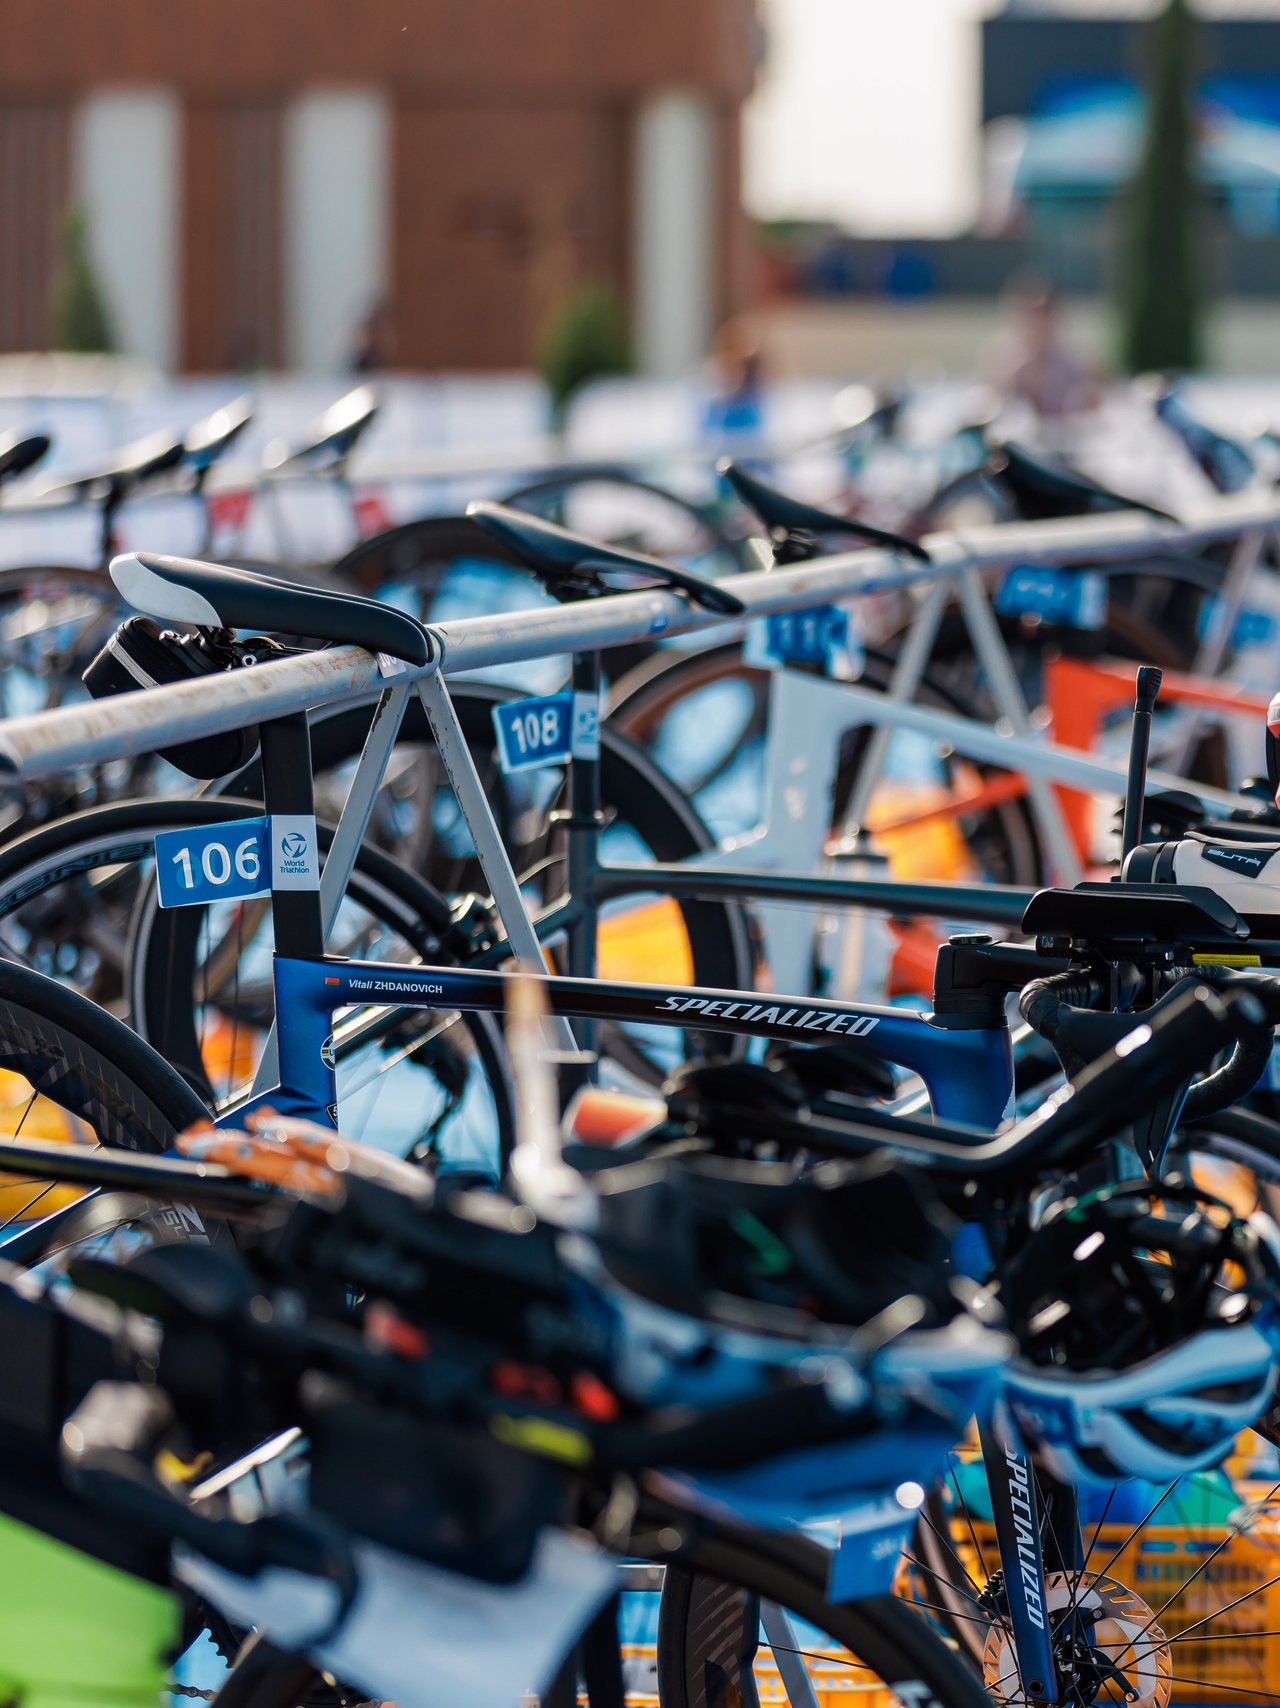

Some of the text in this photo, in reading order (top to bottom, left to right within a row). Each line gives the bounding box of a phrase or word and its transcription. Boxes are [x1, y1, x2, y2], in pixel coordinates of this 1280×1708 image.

[511, 708, 560, 754] 108
[172, 837, 261, 889] 106
[280, 866, 310, 874] Triathlon
[349, 979, 443, 994] Vitali ZHDANOVICH
[655, 996, 881, 1037] SPECIALIZED
